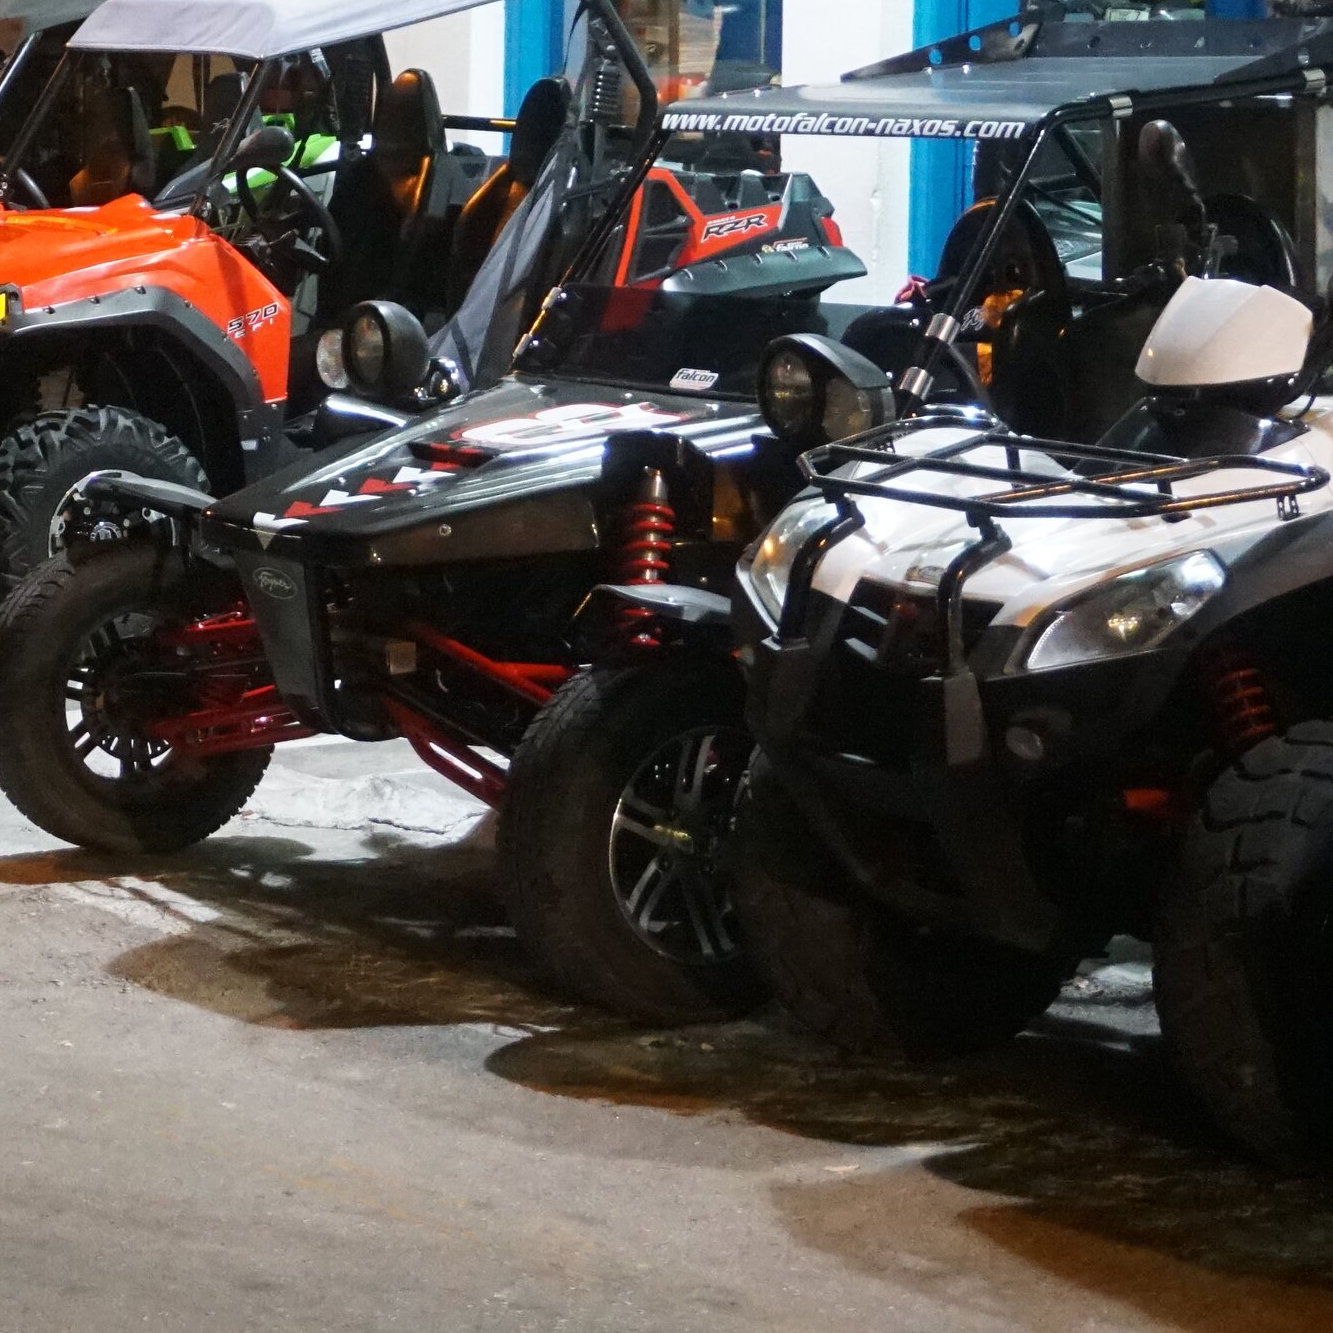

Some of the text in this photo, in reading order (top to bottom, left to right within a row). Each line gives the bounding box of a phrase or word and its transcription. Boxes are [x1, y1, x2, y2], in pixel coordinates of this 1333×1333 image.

[662, 112, 1025, 138] www.motofalcon-naxos.com
[701, 213, 768, 243] RZR
[228, 302, 278, 334] 570
[676, 370, 715, 382] falcon
